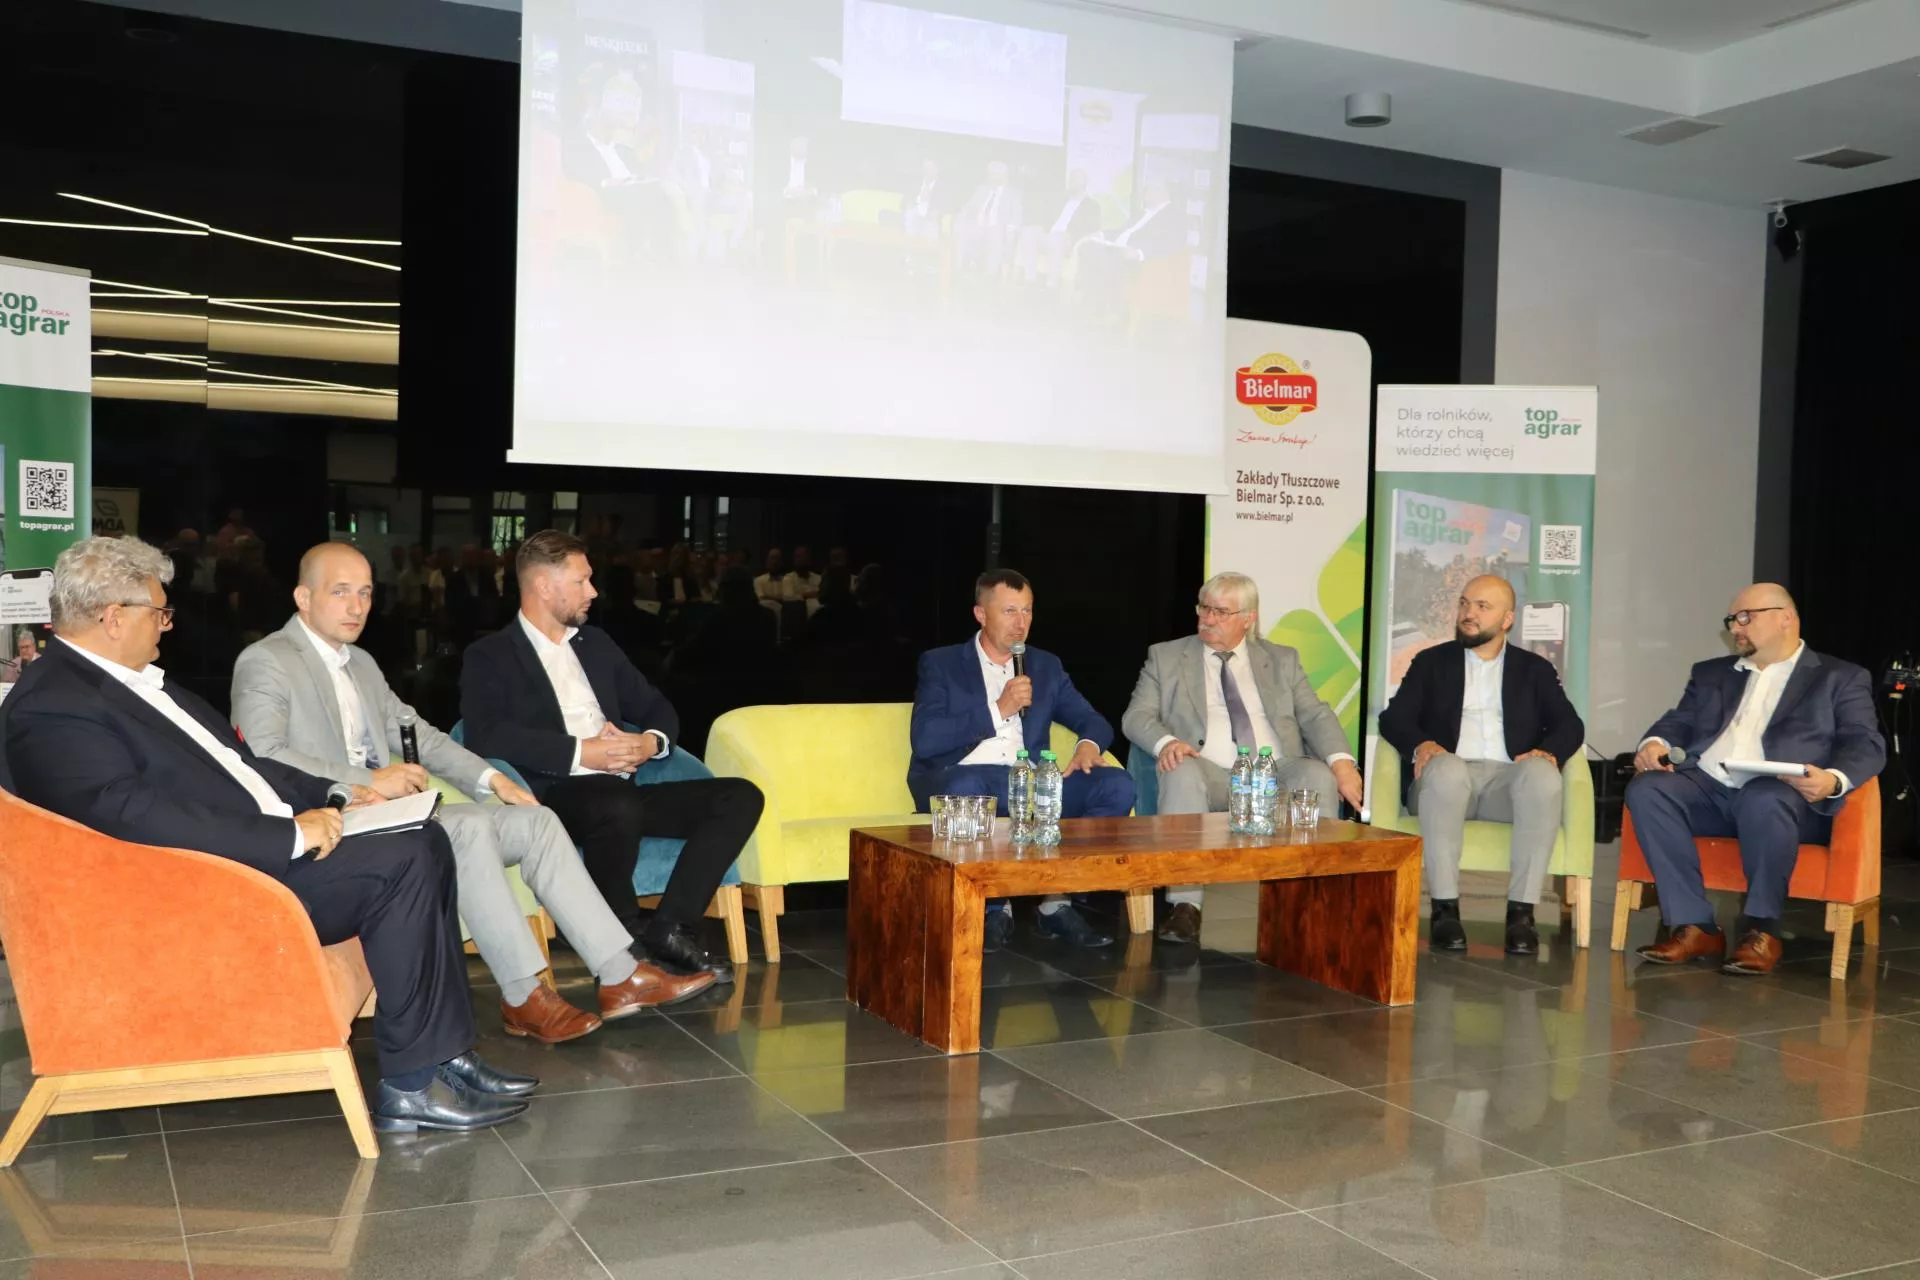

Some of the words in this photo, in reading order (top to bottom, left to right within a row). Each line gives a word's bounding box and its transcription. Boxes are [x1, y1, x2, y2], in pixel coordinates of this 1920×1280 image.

[0, 292, 38, 314] op
[1243, 378, 1312, 398] Bielmar
[1397, 408, 1421, 420] Dla
[1427, 408, 1493, 423] rolników,
[1524, 407, 1558, 424] top
[1396, 425, 1443, 441] którzy
[1447, 426, 1485, 442] chcą
[1524, 422, 1581, 439] agrar
[1396, 444, 1461, 456] wiedzieć
[1466, 445, 1515, 460] więcej
[1236, 470, 1280, 489] Zakłady
[1281, 473, 1340, 489] Tłuszczowe
[1236, 489, 1277, 504] Bielmar
[1279, 491, 1295, 508] Sp.
[1298, 495, 1303, 506] z
[1306, 496, 1324, 507] o.o.
[1236, 510, 1293, 524] www.bielmar.pl
[1405, 498, 1447, 525] top
[20, 521, 75, 533] topagrar.pl
[1404, 519, 1473, 544] agrar
